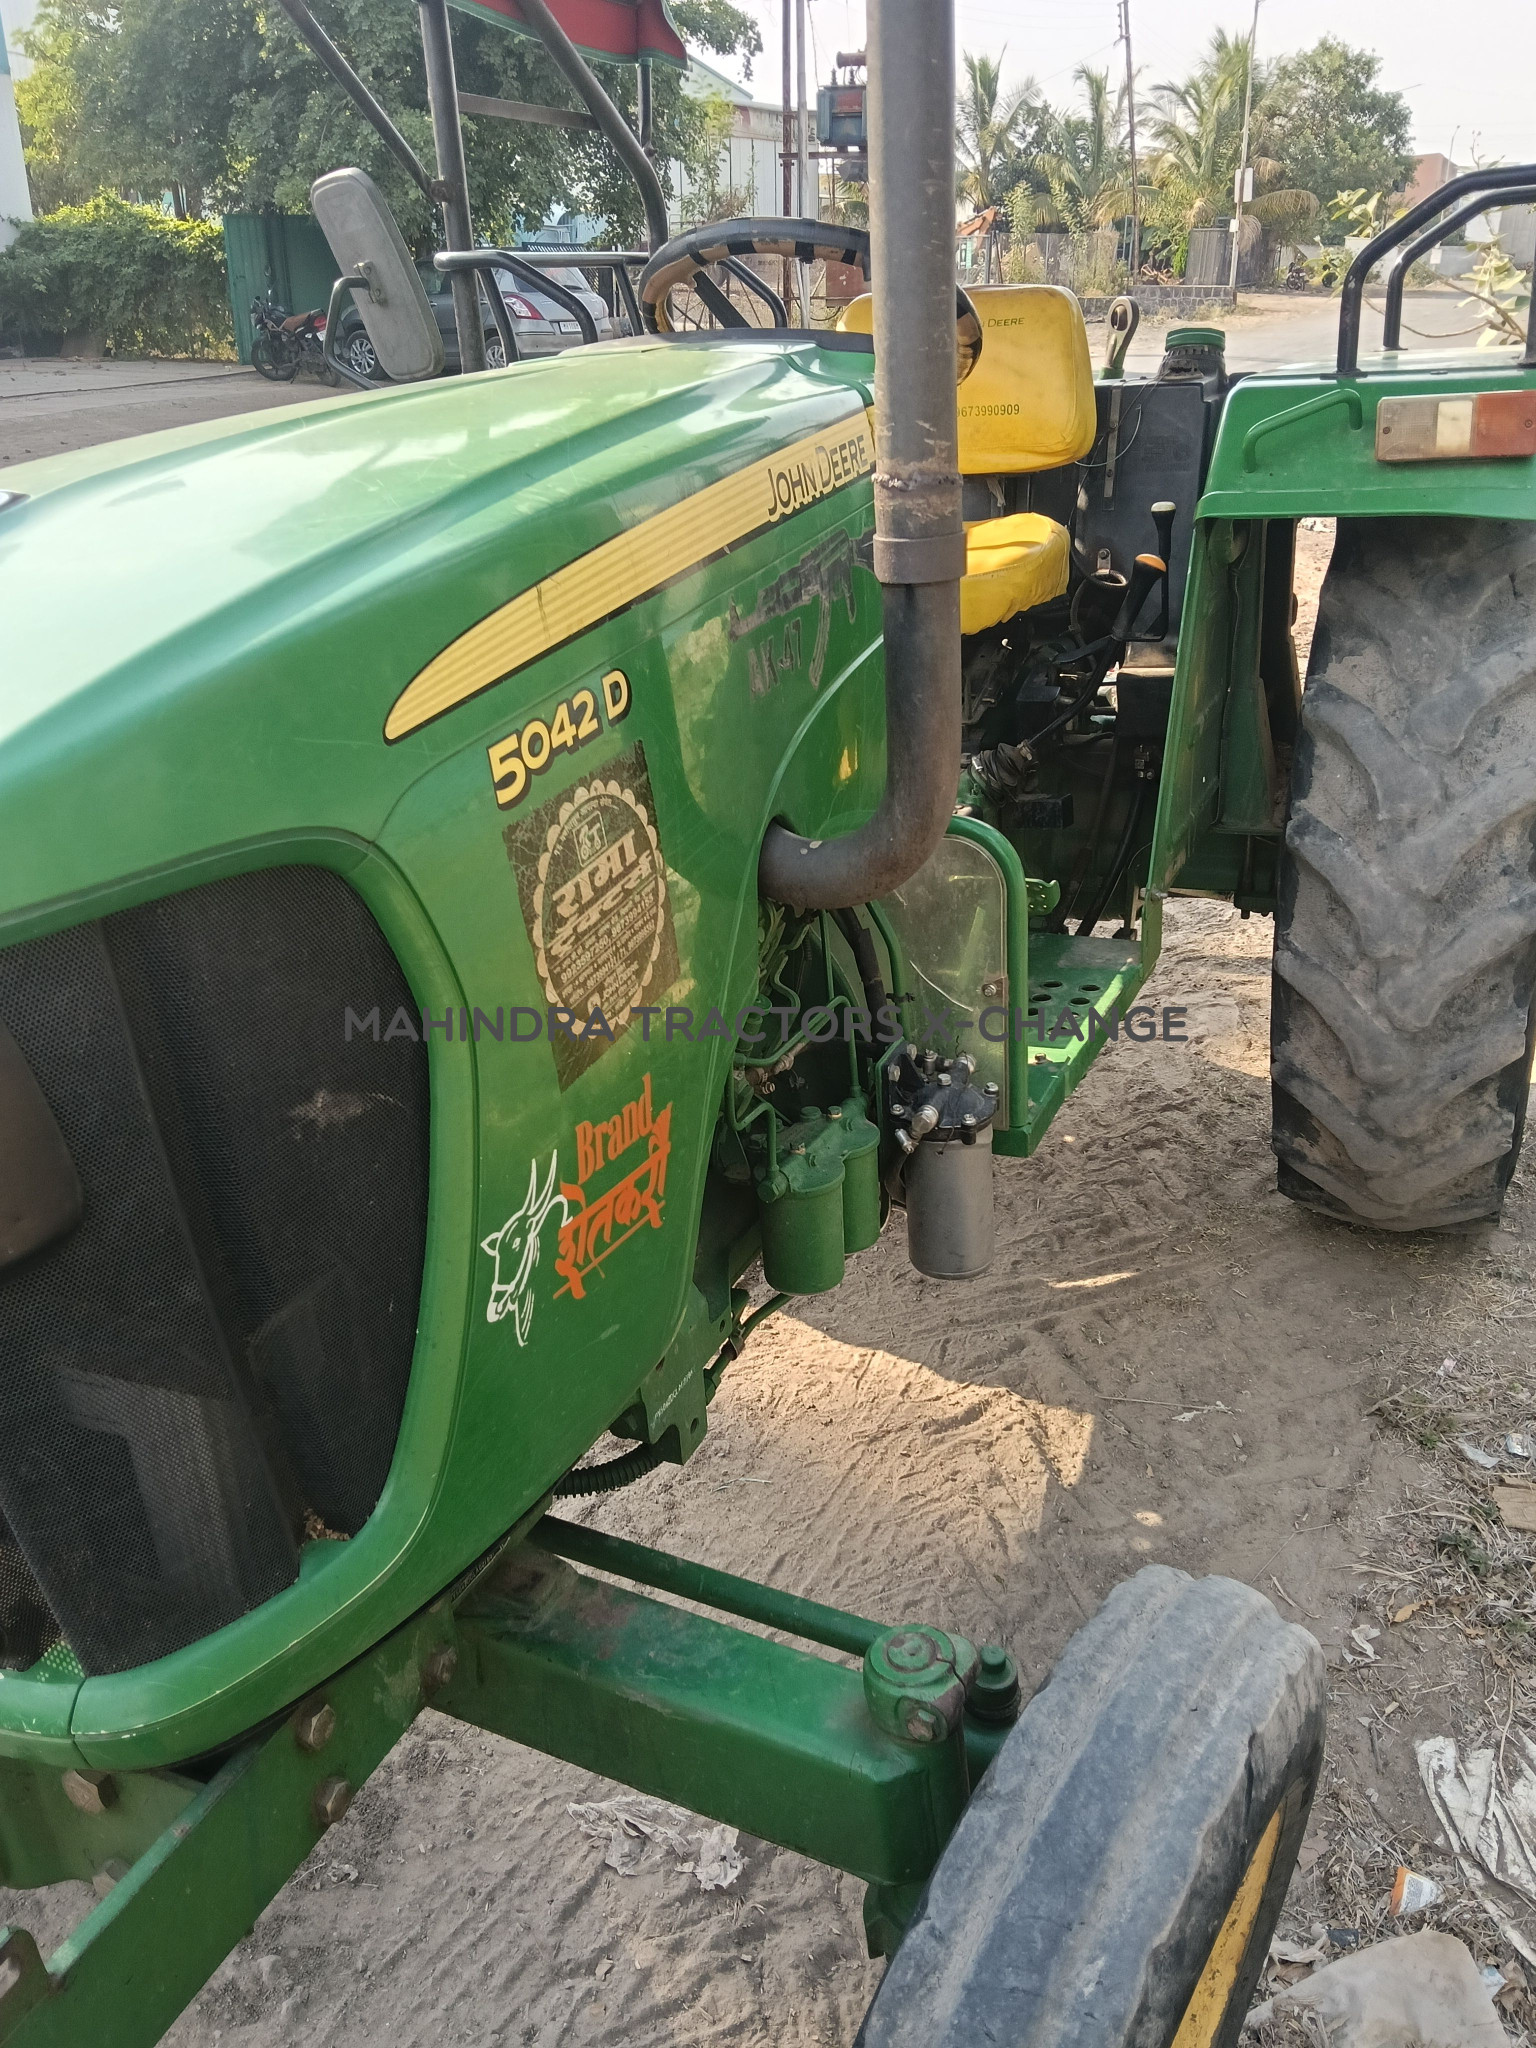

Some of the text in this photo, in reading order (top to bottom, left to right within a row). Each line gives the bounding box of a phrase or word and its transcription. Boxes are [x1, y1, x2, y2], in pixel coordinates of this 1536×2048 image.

[988, 318, 1025, 327] DEERE
[767, 434, 868, 516] JOHN DEERE
[487, 668, 633, 811] 5042 D
[552, 828, 638, 919] रामा
[575, 1072, 654, 1185] Brand
